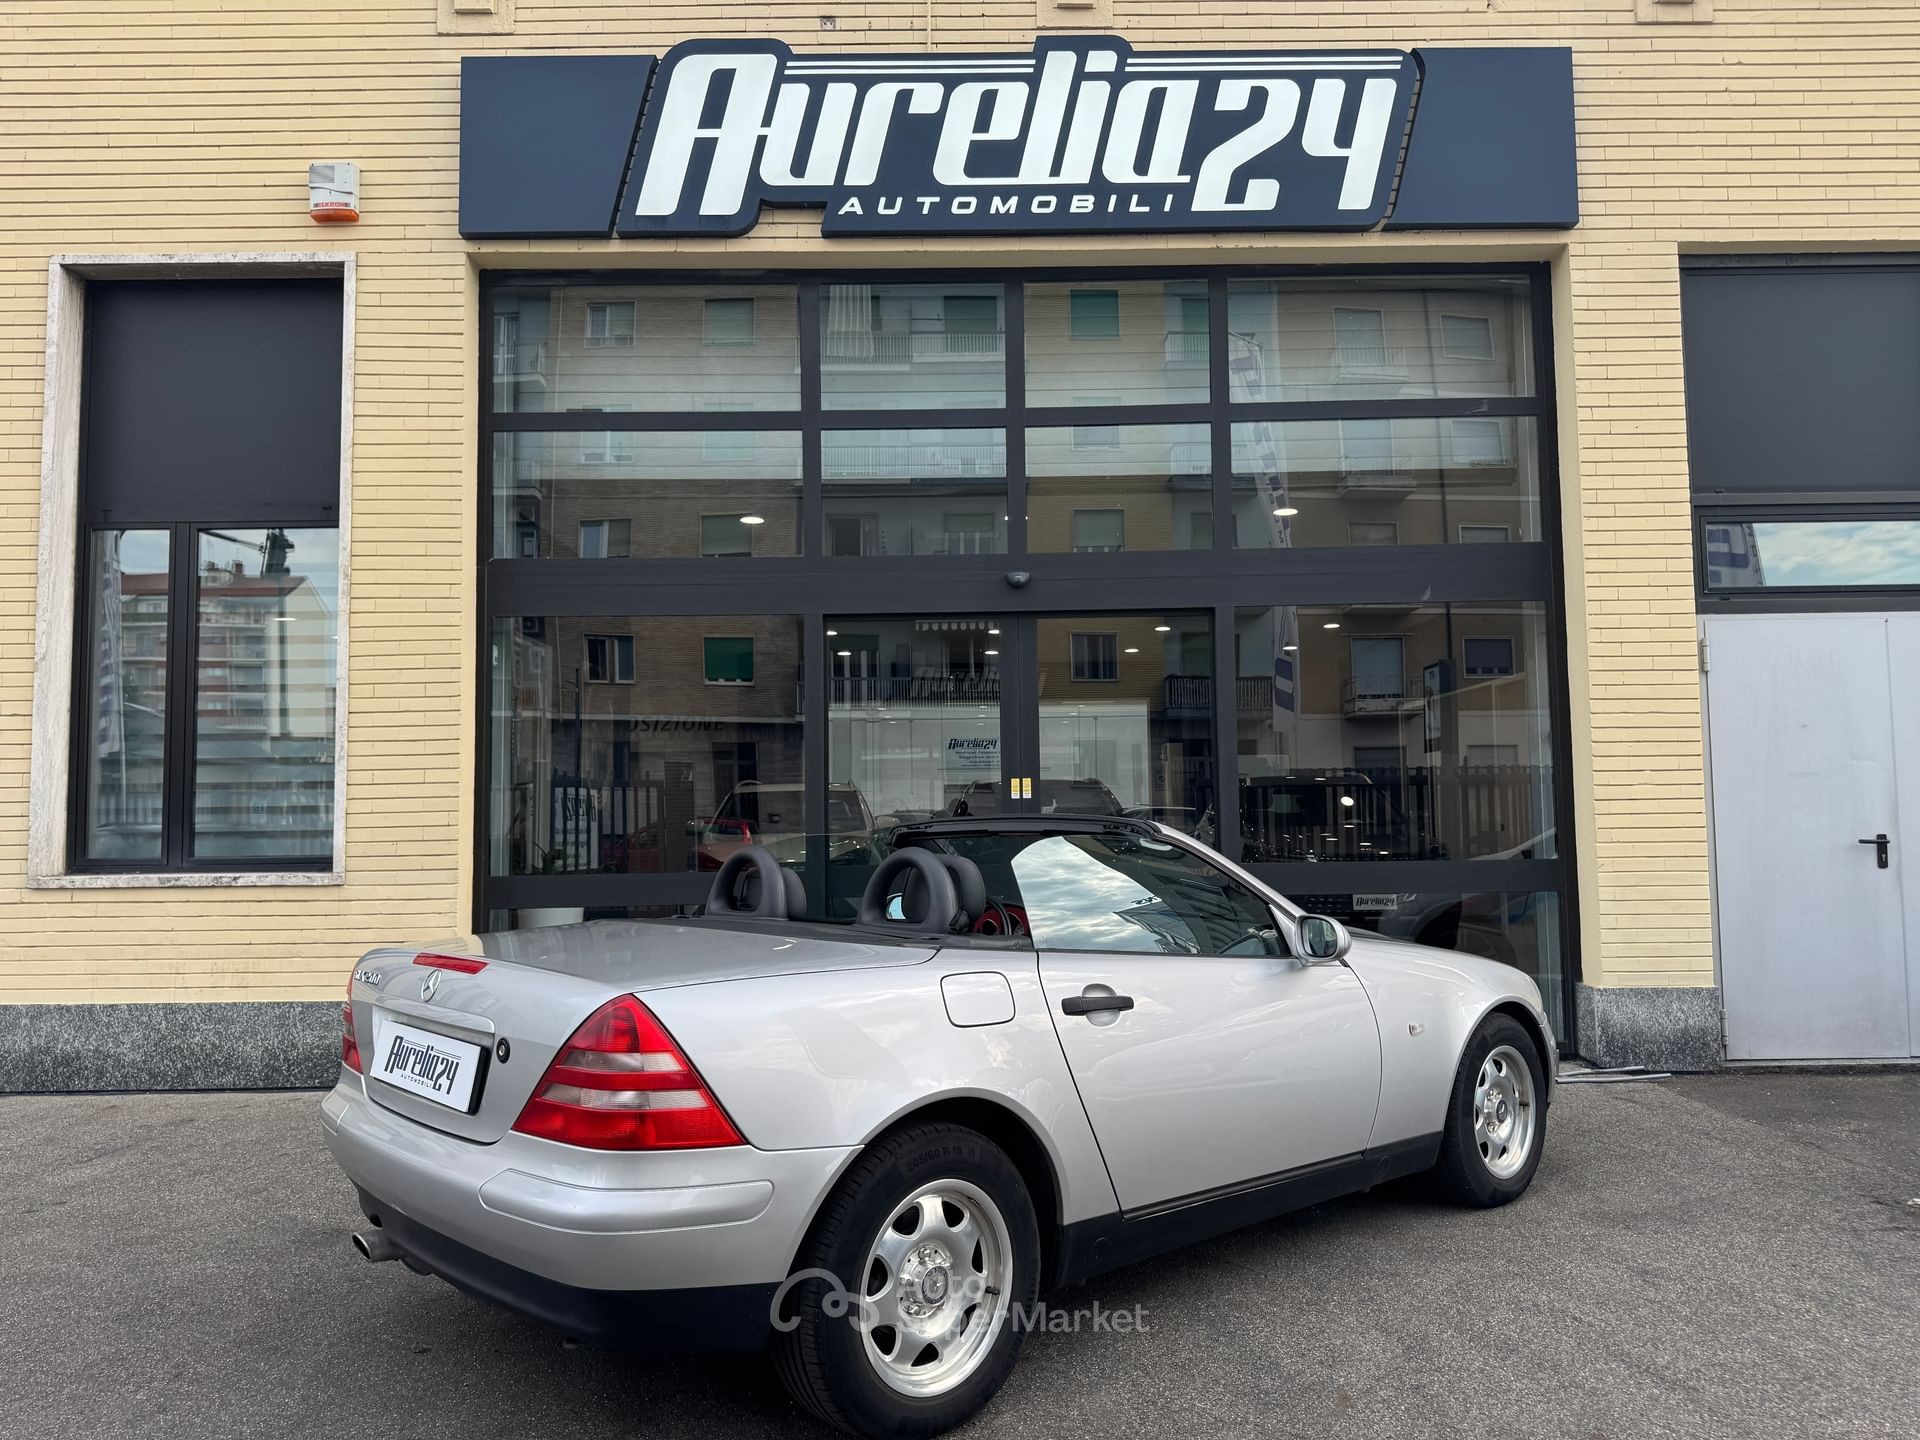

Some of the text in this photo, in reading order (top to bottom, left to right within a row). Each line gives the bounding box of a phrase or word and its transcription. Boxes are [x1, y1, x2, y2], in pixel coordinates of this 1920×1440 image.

[634, 50, 1397, 216] Aurelia24
[838, 194, 1173, 215] AUTOMOBILI
[947, 738, 997, 750] Aurelia24
[383, 1034, 460, 1096] Aurelia24
[400, 1073, 433, 1089] AUTOMOBILI
